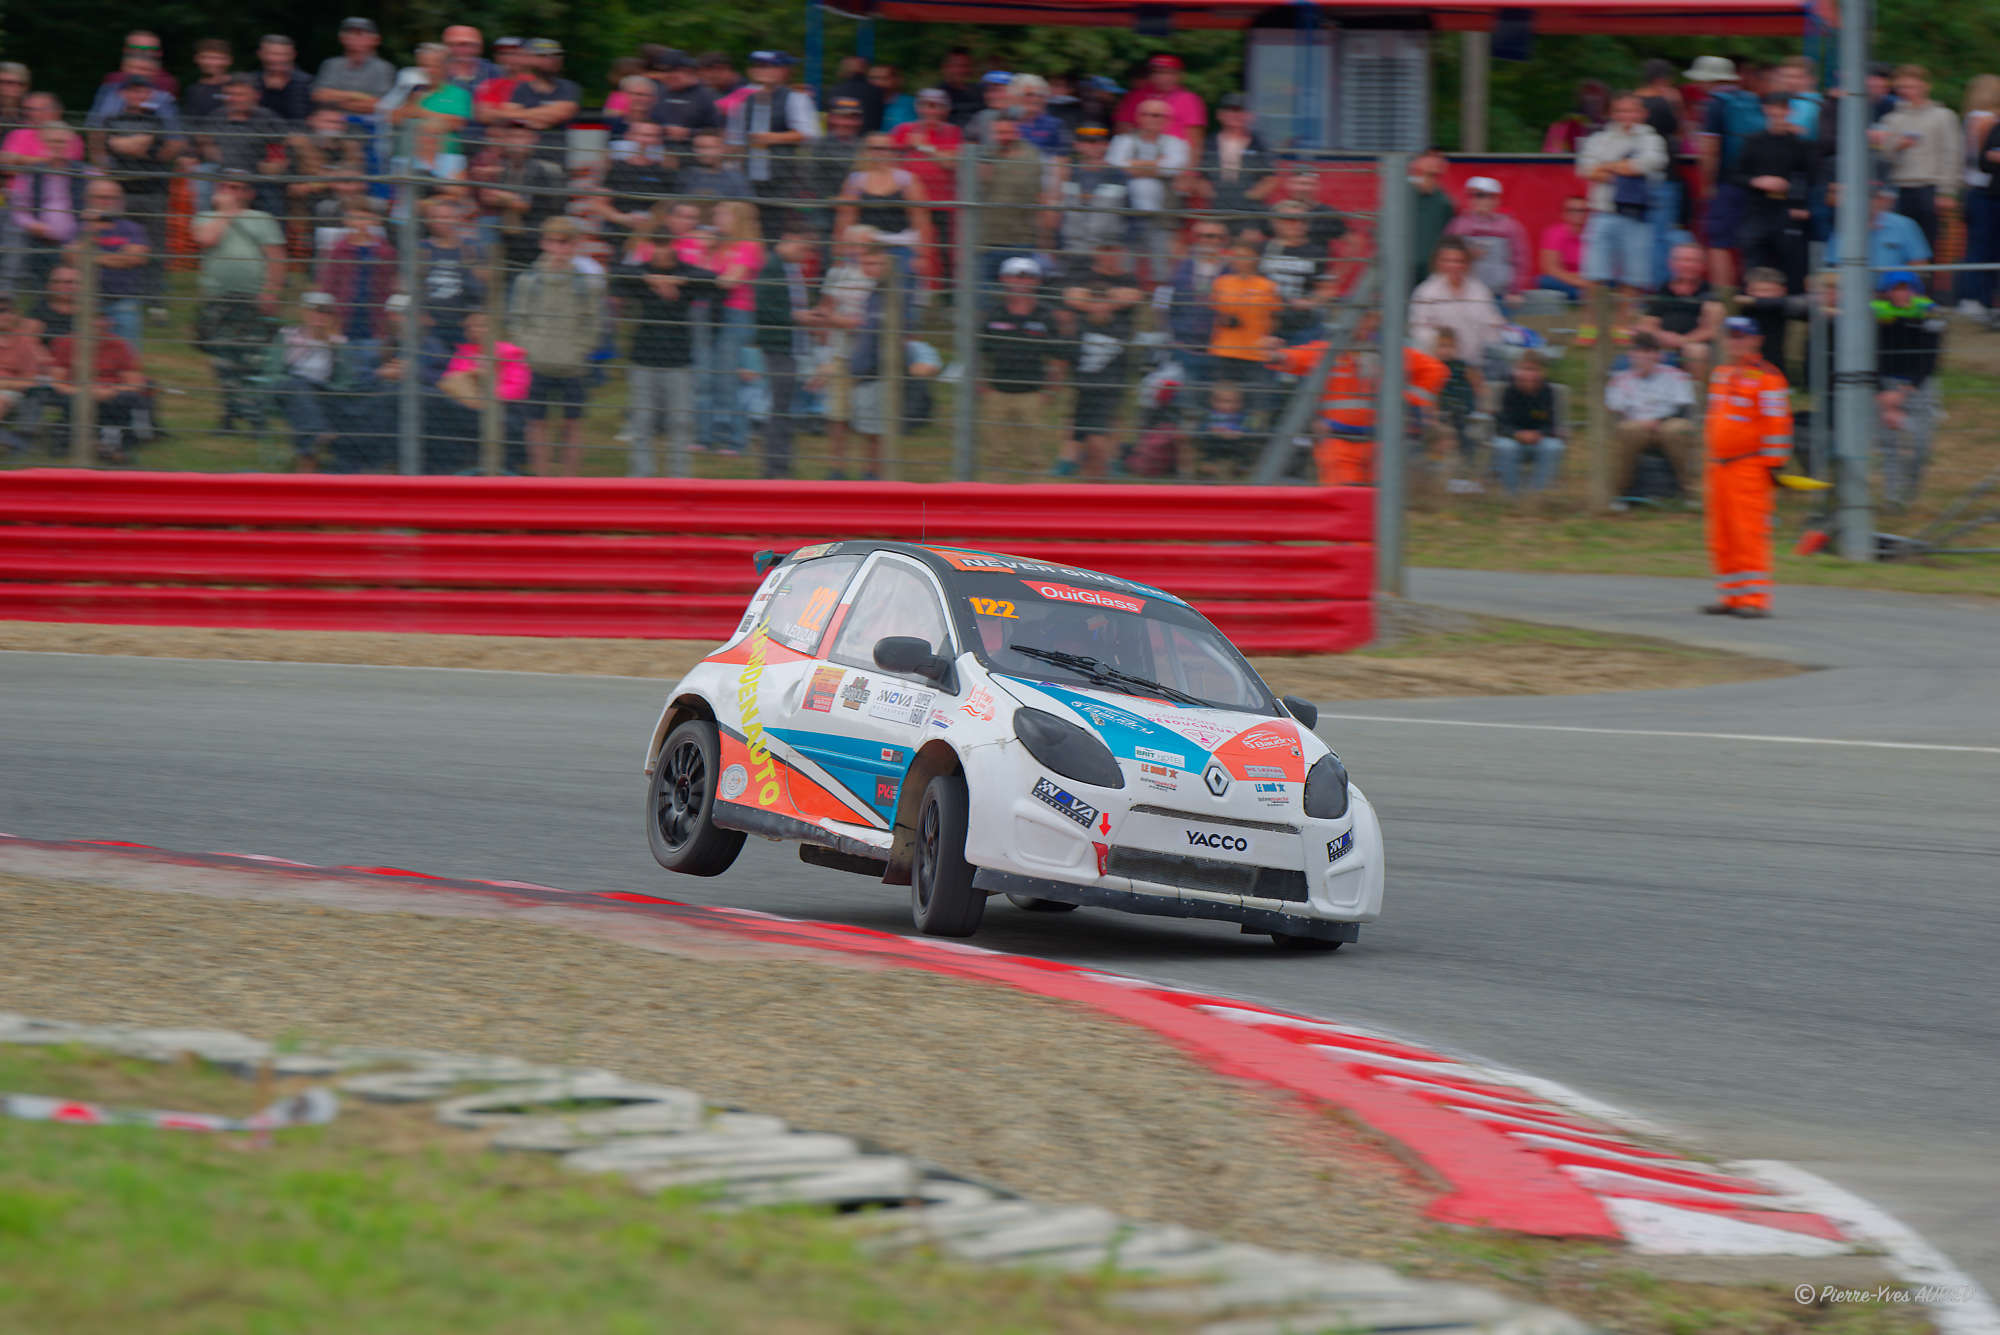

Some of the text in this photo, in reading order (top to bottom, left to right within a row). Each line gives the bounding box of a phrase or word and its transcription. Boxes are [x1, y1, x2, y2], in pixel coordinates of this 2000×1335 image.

[962, 558, 1057, 574] NEVER
[797, 586, 839, 632] 122
[968, 596, 1020, 620] 122
[1040, 585, 1139, 612] OuiGlass
[1038, 780, 1096, 820] NOVA
[1186, 830, 1249, 852] YACCO
